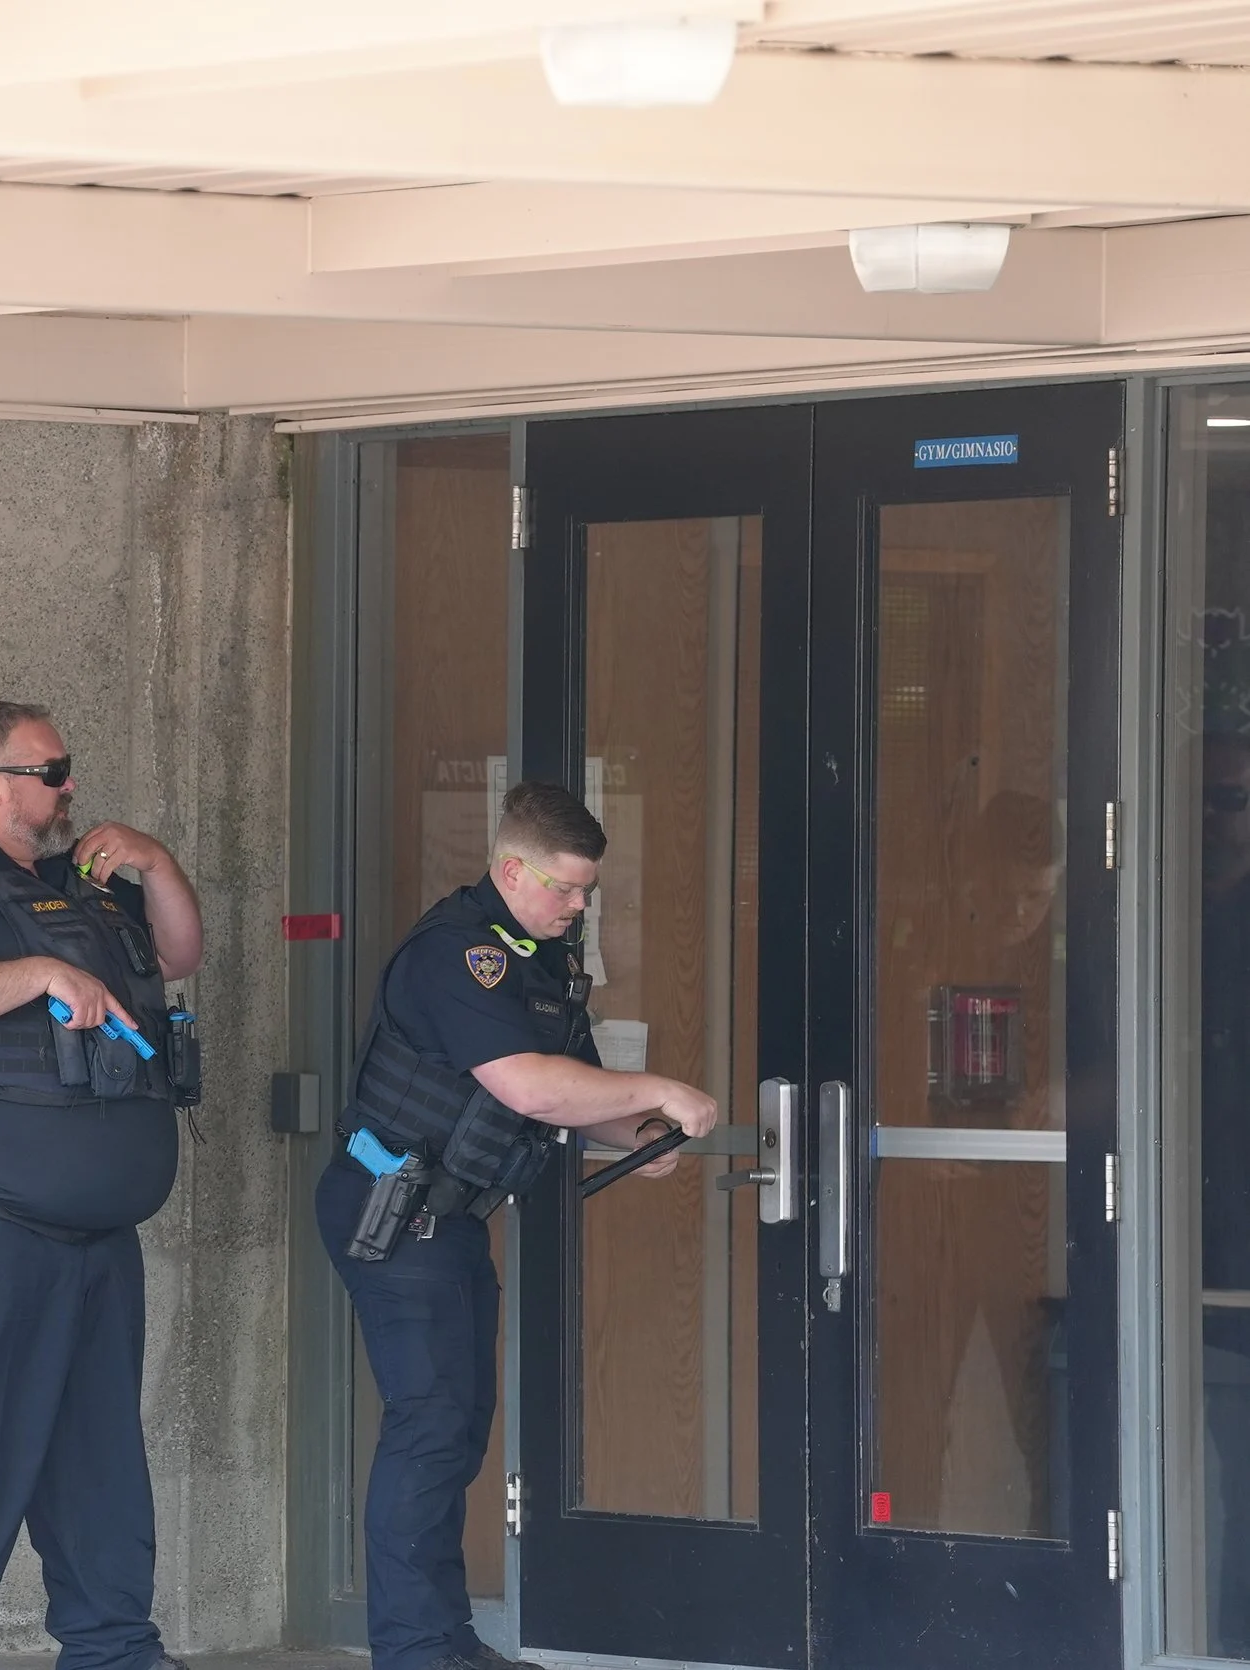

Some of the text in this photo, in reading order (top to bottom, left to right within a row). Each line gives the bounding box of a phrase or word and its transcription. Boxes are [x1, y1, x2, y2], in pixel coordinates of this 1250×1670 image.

[918, 440, 1013, 461] GYM/GIMNASIO
[32, 899, 69, 912] SCHOEN
[470, 949, 503, 958] MEDFORD
[534, 1002, 561, 1015] GLADMAN
